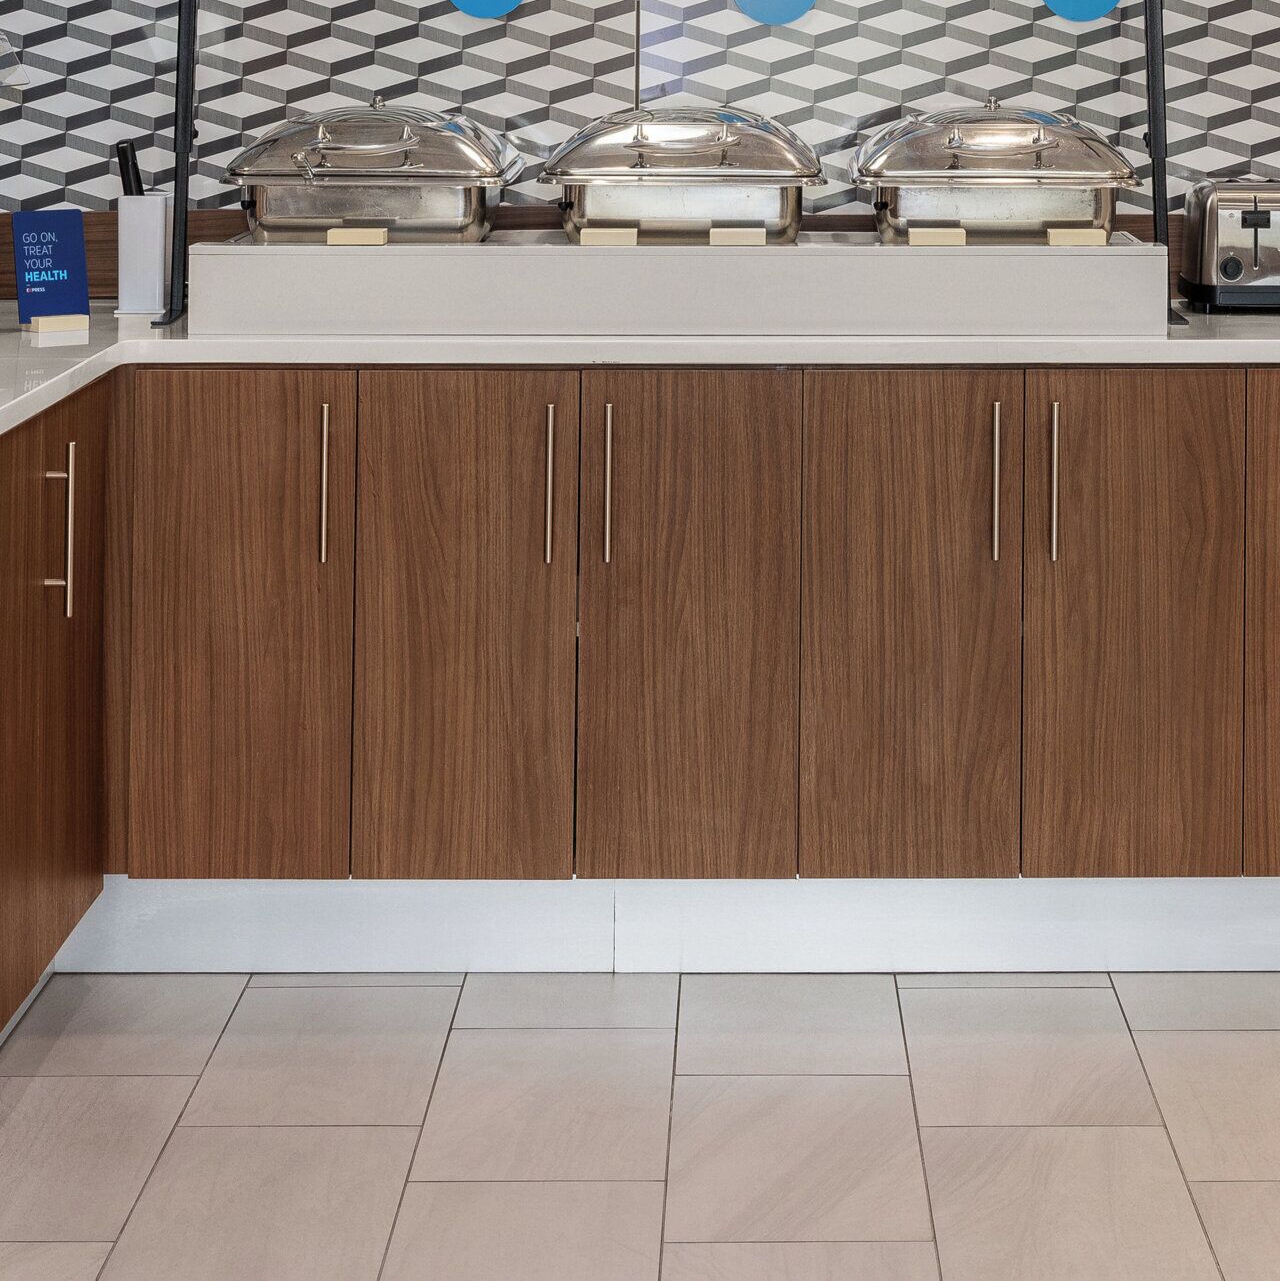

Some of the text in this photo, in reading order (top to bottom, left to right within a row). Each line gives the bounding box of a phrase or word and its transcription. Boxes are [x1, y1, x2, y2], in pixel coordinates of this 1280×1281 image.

[23, 232, 58, 243] GO ON,
[23, 245, 53, 256] TREAT
[24, 258, 53, 269] YOUR
[25, 270, 68, 282] HEALTH
